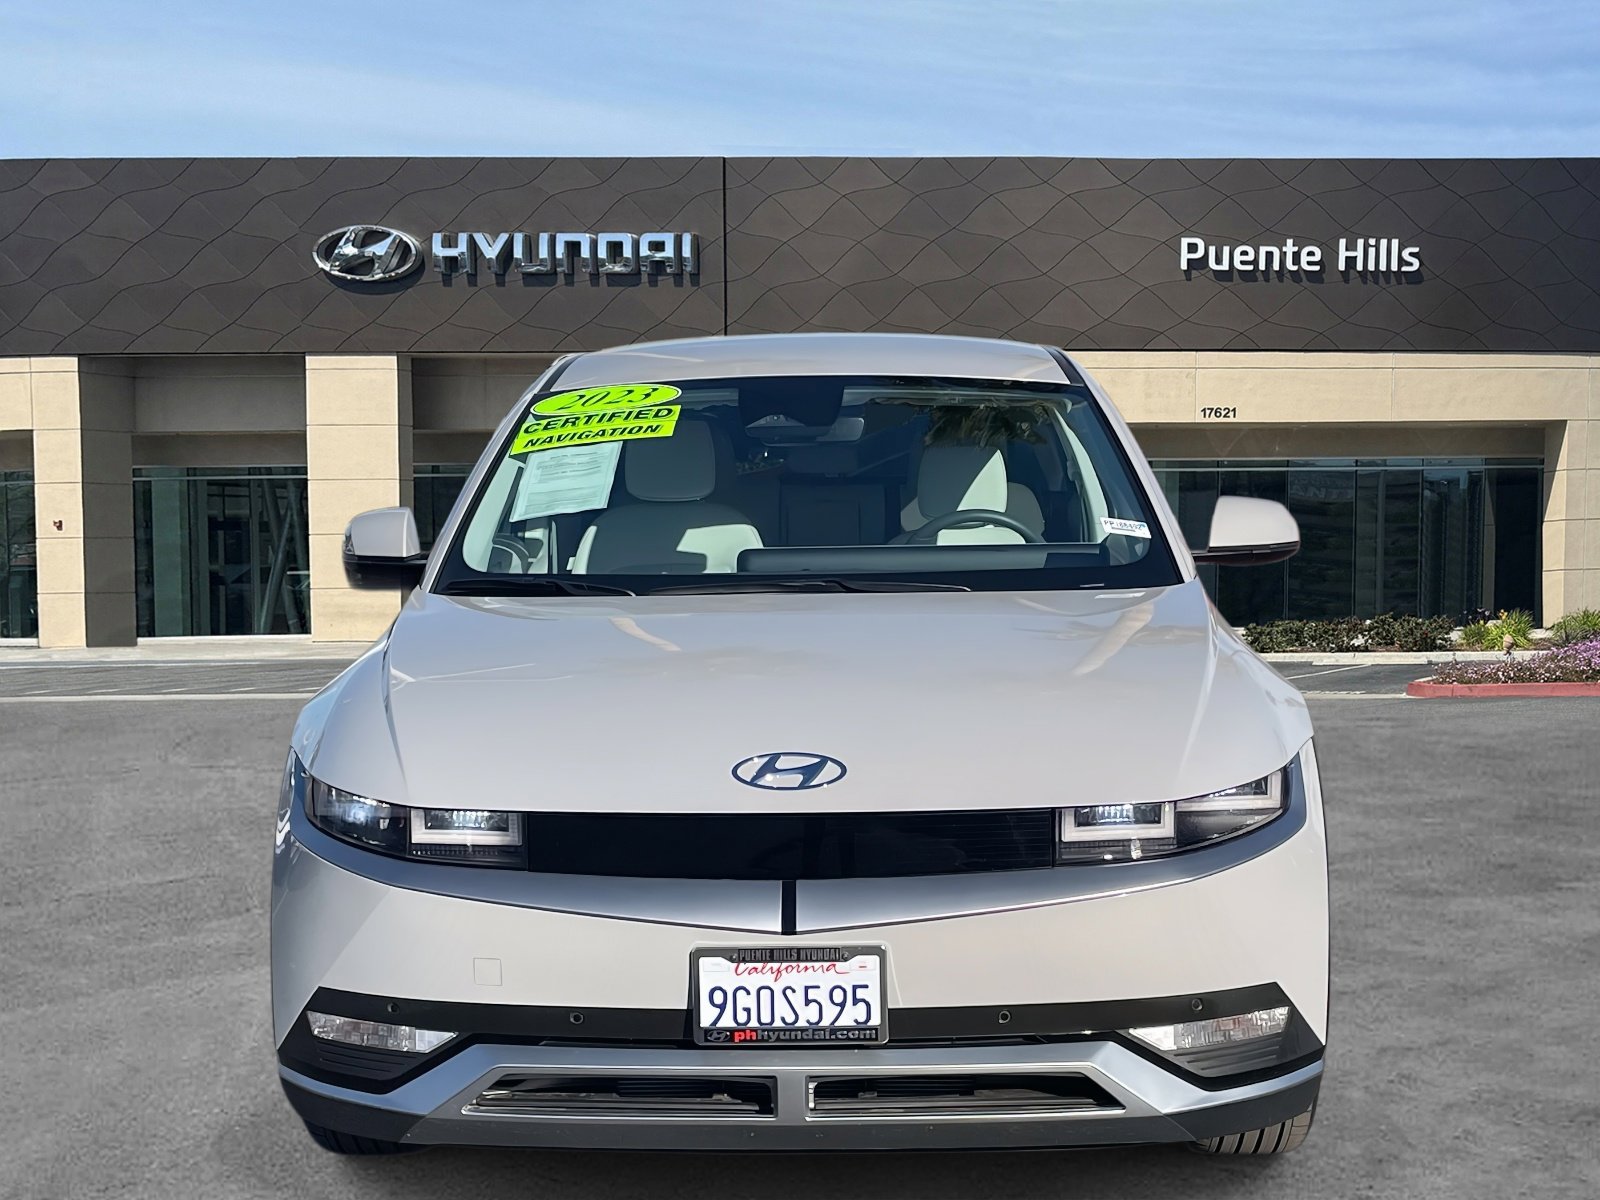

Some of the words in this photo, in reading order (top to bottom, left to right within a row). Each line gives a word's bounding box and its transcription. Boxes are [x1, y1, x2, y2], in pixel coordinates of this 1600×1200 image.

[432, 231, 698, 274] HYUNDAI
[1179, 236, 1323, 272] Puente
[1337, 237, 1421, 273] Hills
[552, 386, 660, 412] 2023
[522, 406, 674, 435] CERTIFIED
[1200, 406, 1237, 419] 17621
[522, 423, 664, 449] NAVIGATION
[739, 948, 771, 961] PUENTE
[773, 948, 798, 961] HILLS
[799, 948, 840, 961] HYUNDAI
[734, 961, 850, 983] California
[707, 983, 872, 1027] 9GOS595
[733, 1028, 877, 1043] phhyundai.com
